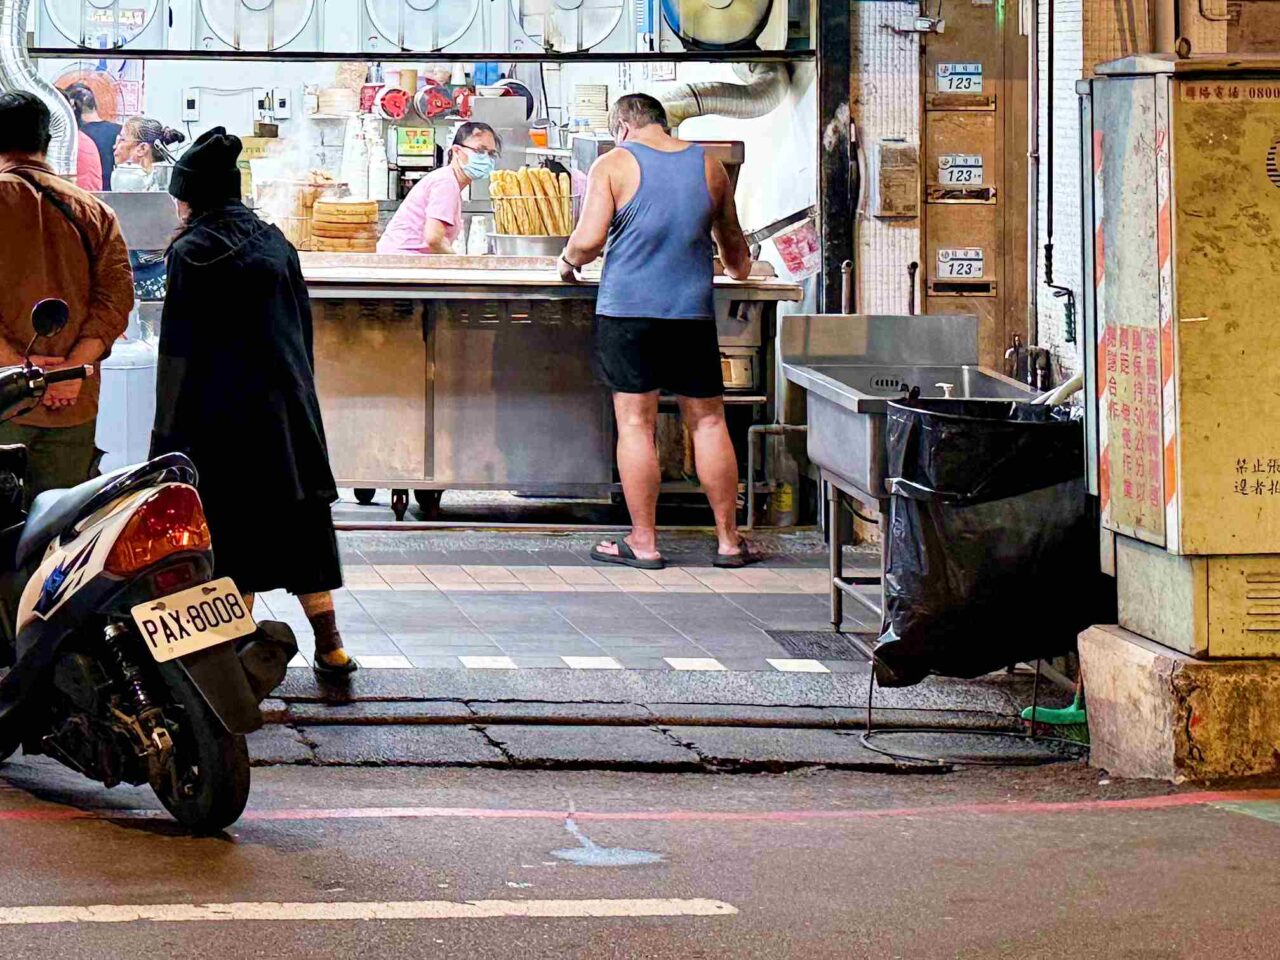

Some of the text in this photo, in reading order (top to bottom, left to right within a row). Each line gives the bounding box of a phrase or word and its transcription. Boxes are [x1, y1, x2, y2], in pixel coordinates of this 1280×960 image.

[947, 77, 972, 90] 123
[948, 169, 972, 182] 123
[949, 262, 973, 275] 123
[141, 591, 246, 648] PAX-8008
